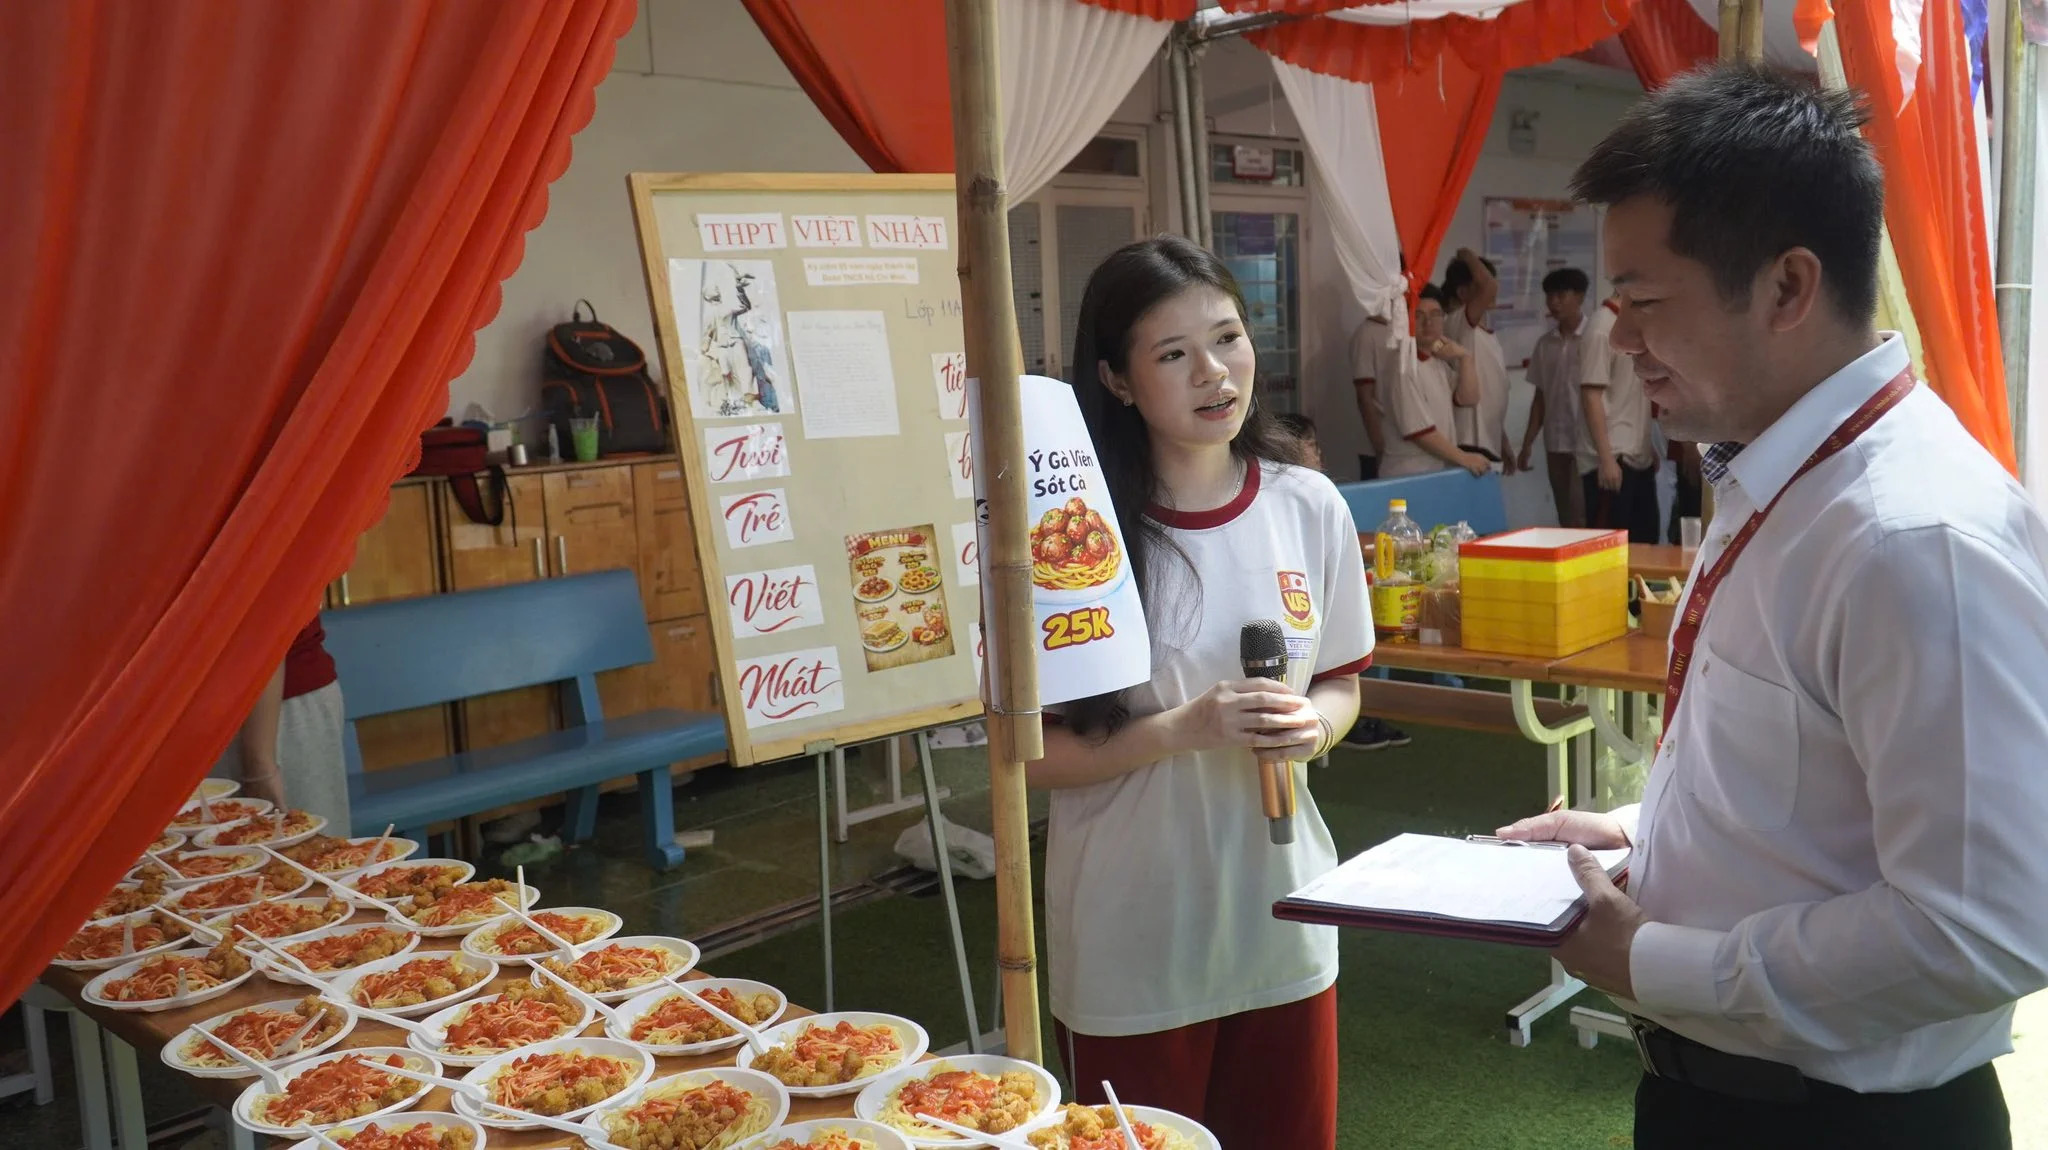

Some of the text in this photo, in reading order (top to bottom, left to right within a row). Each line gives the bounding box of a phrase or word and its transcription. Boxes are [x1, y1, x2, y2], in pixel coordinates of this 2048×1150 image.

[704, 215, 943, 248] THPT VIỆT NHẬT
[1028, 448, 1094, 473] Ý Gà Viên
[1034, 473, 1087, 498] Sốt Cà
[867, 533, 910, 549] MENU
[1042, 606, 1115, 651] 25K
